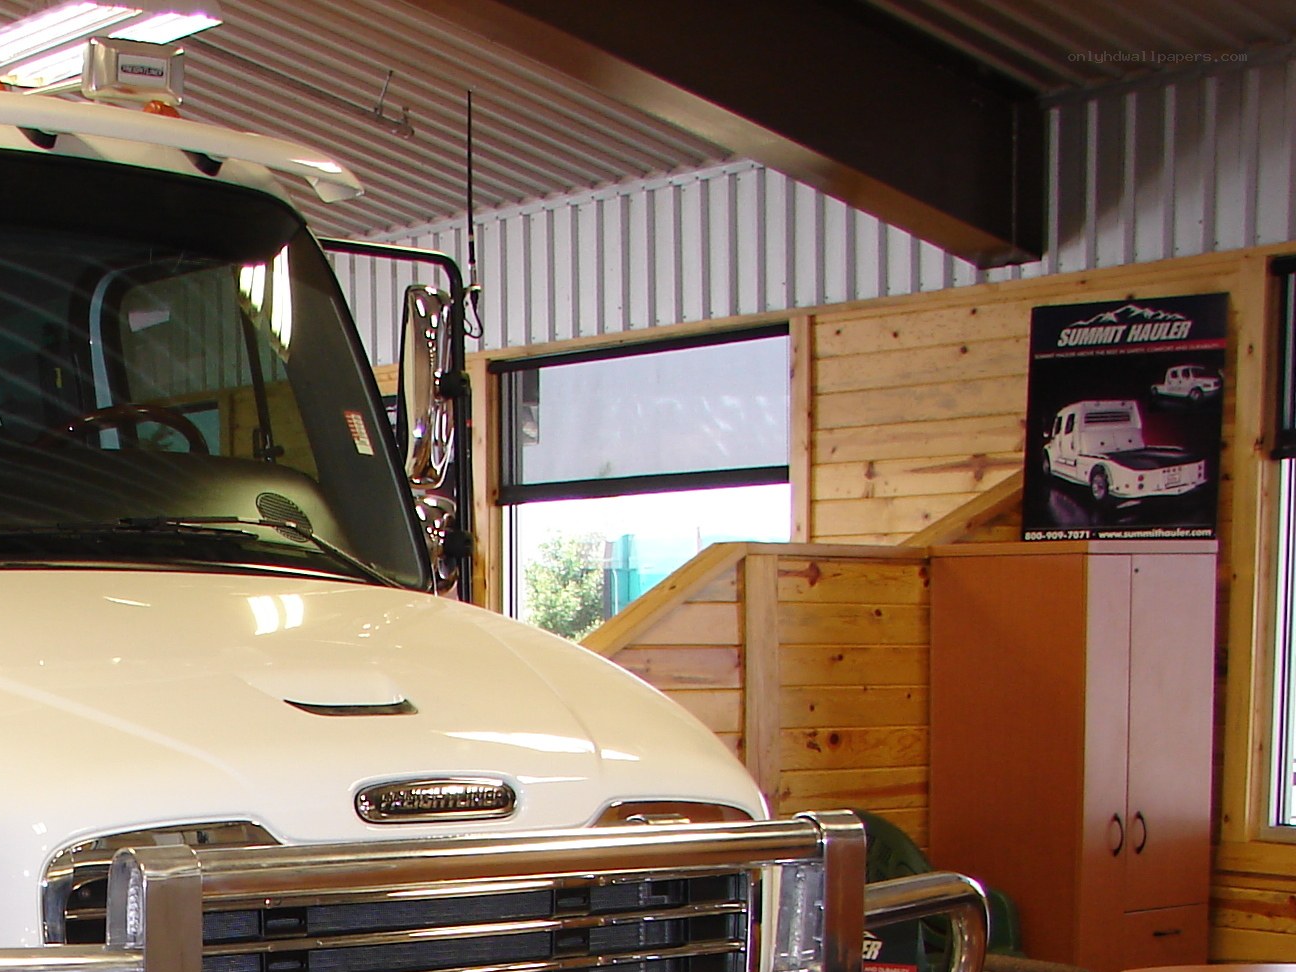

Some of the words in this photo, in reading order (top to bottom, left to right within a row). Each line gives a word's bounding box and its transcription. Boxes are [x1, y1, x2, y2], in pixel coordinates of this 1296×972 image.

[1057, 324, 1127, 347] SUMMIT
[1127, 320, 1192, 343] HAULER
[1024, 530, 1090, 541] 800-909-7071
[1098, 527, 1212, 539] www.summithauler.com
